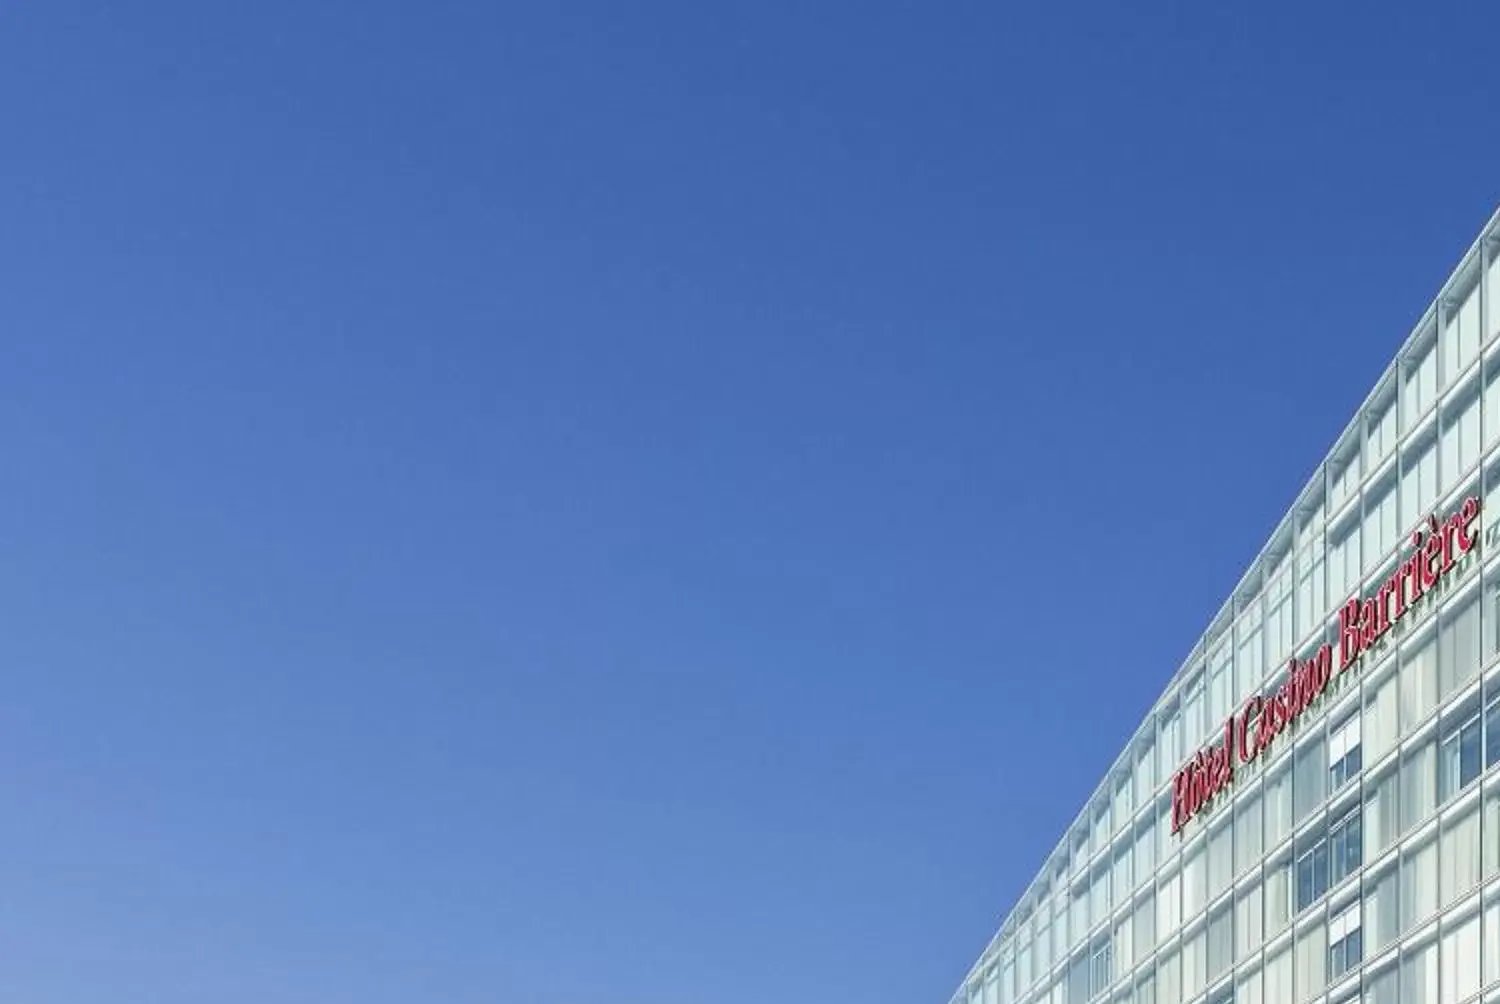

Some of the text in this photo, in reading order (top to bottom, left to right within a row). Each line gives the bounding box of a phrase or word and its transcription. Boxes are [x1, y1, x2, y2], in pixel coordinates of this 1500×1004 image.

[1171, 496, 1480, 834] Hôtel Casino Barrière
